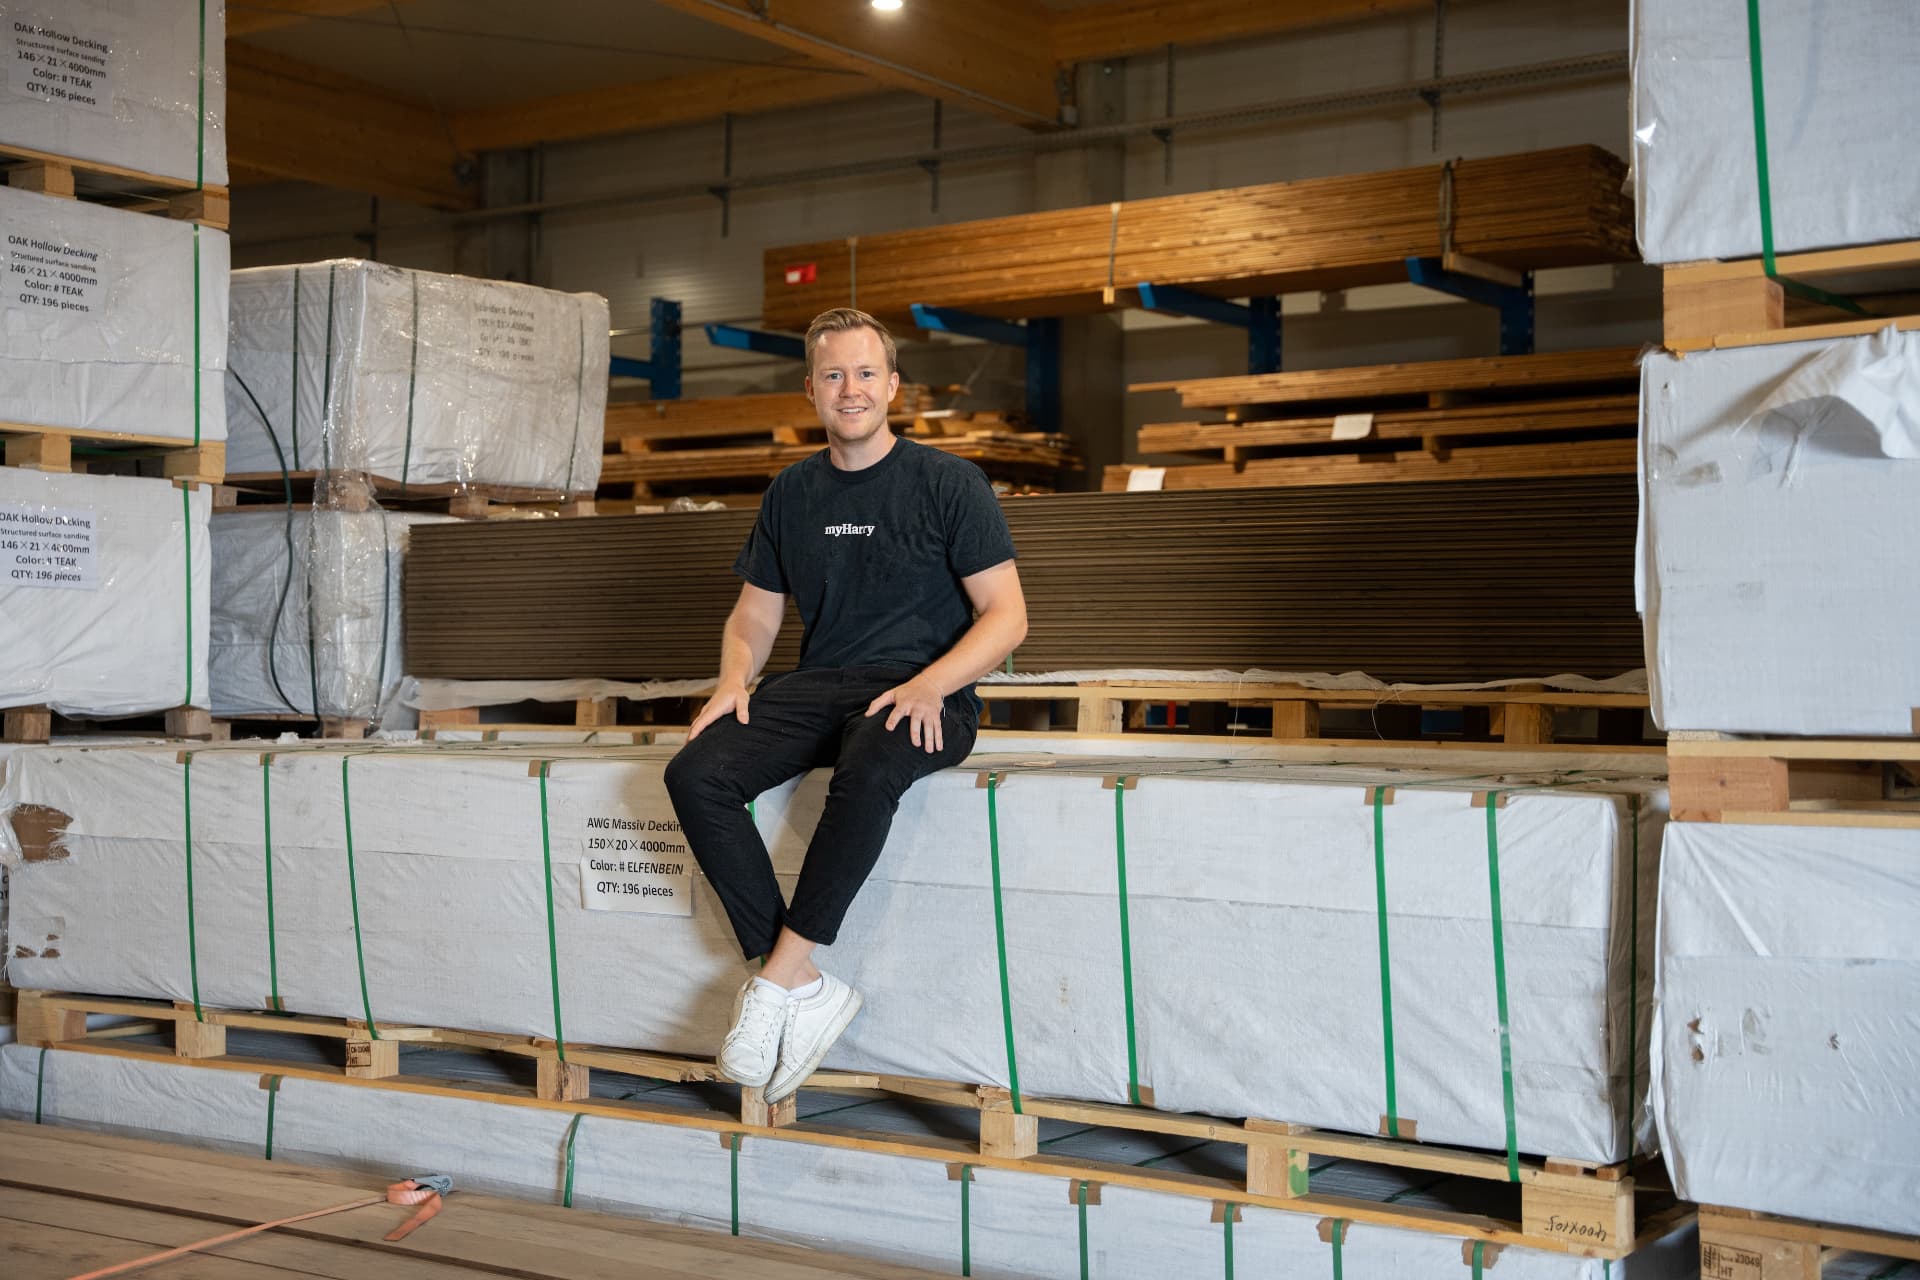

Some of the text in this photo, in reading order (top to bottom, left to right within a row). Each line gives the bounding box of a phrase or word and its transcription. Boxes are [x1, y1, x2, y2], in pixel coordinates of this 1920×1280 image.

[14, 22, 108, 54] OAK Hollow Decking
[16, 38, 105, 66] Structured surface sanding
[33, 67, 60, 81] Color:
[70, 76, 92, 89] TEAK
[26, 81, 96, 105] QTY: 196 pieces
[8, 235, 98, 262] OAK Hollow Decking
[24, 279, 52, 292] Color:
[61, 285, 84, 297] TEAK
[20, 293, 89, 312] QTY: 196 pieces
[0, 512, 19, 522] OAK
[21, 514, 53, 525] Hollow
[0, 528, 37, 537] Structured
[63, 533, 90, 541] sanding
[825, 523, 876, 537] myHarry
[15, 555, 45, 565] Color:
[55, 557, 77, 566] TEAK
[11, 569, 81, 582] QTY: 196 pieces
[587, 817, 684, 832] AWG Massiv Deckin
[590, 859, 684, 875] Color: # ELFENBEIN
[597, 881, 674, 898] QTY: 196 pieces
[1721, 1266, 1733, 1277] HT
